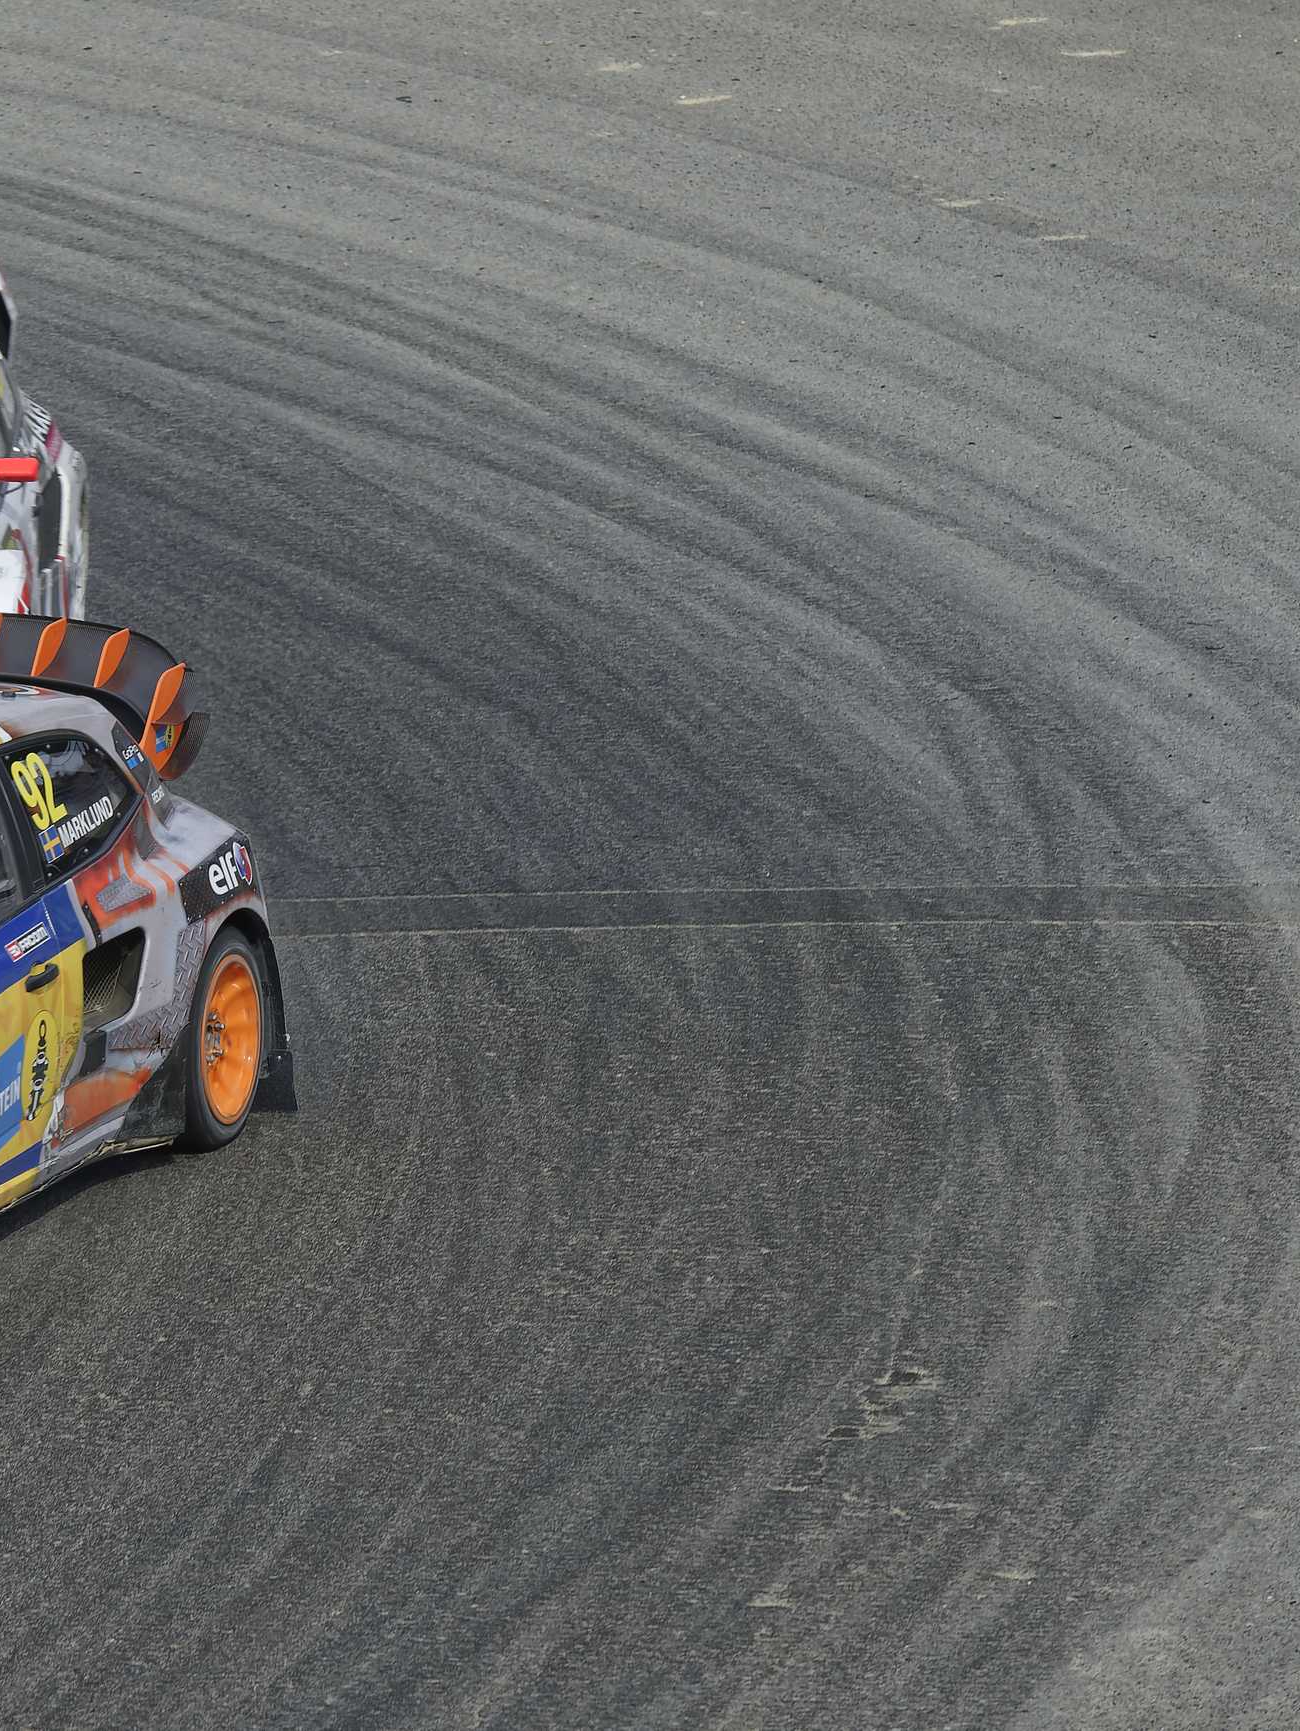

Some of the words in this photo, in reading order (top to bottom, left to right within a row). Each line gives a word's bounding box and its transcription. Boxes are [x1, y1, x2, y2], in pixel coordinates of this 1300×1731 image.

[11, 752, 68, 831] 92
[57, 796, 114, 849] MARKLUND
[208, 851, 239, 896] elf
